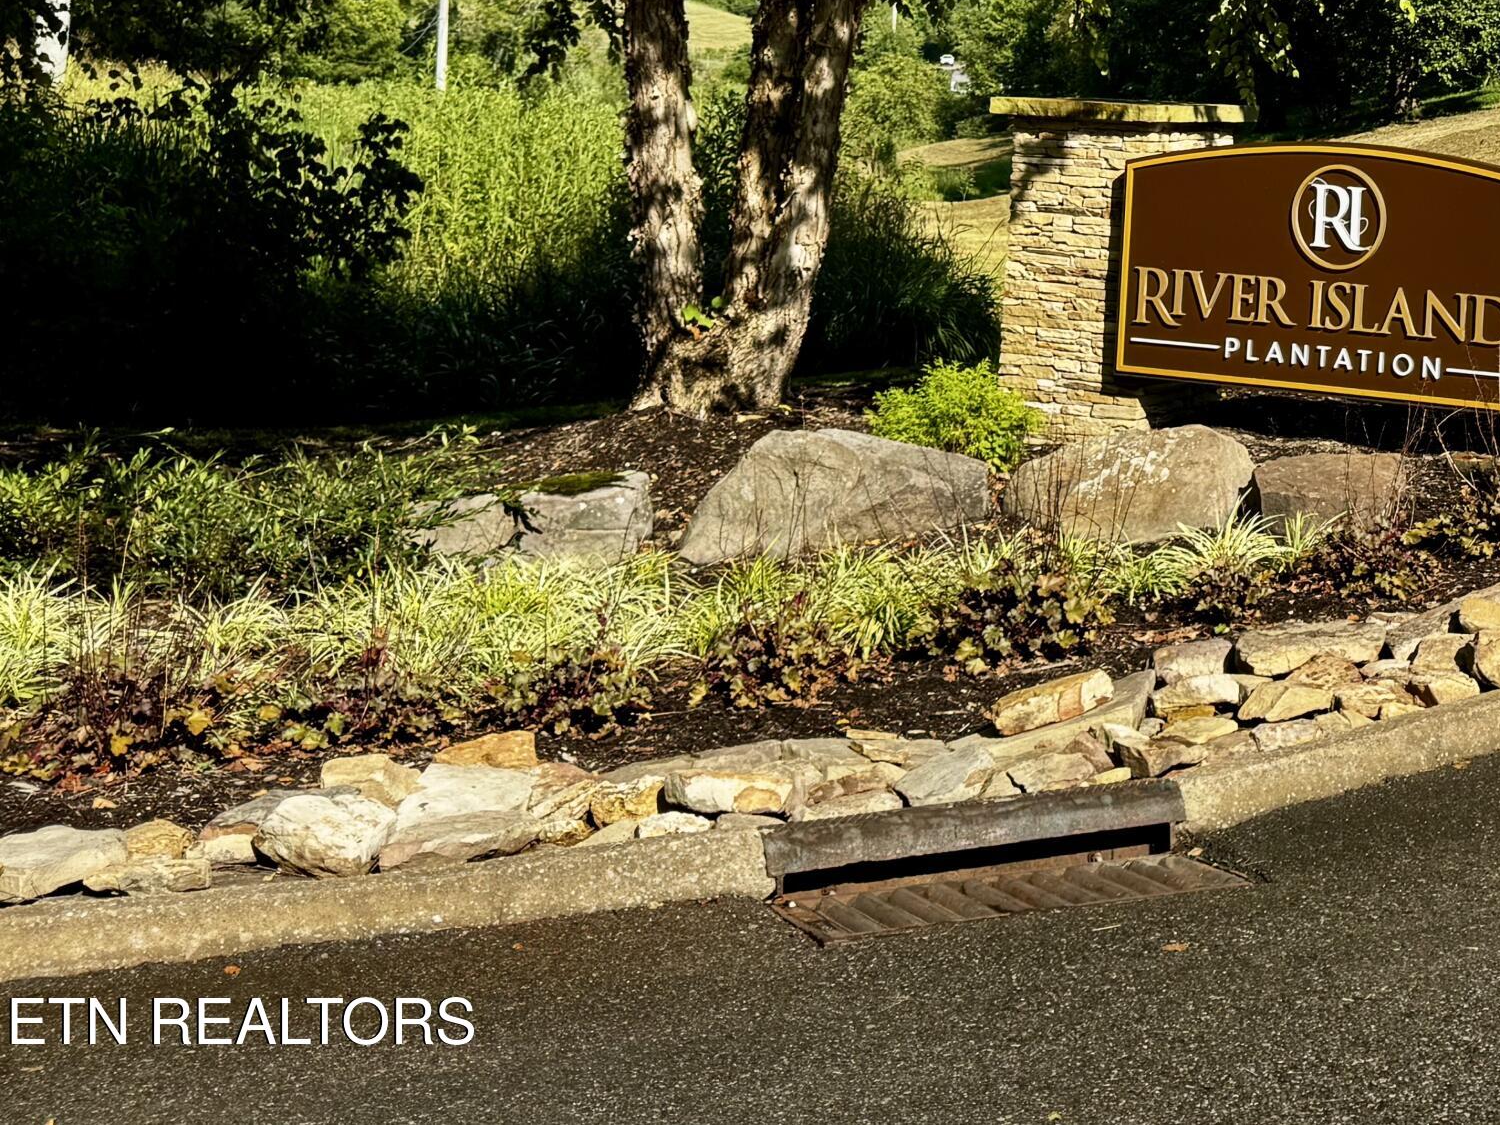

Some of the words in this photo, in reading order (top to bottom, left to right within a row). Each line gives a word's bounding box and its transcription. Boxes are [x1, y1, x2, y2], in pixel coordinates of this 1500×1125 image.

[1305, 179, 1372, 251] RI
[1132, 266, 1297, 327] RIVER
[1224, 336, 1442, 380] PLANTATION
